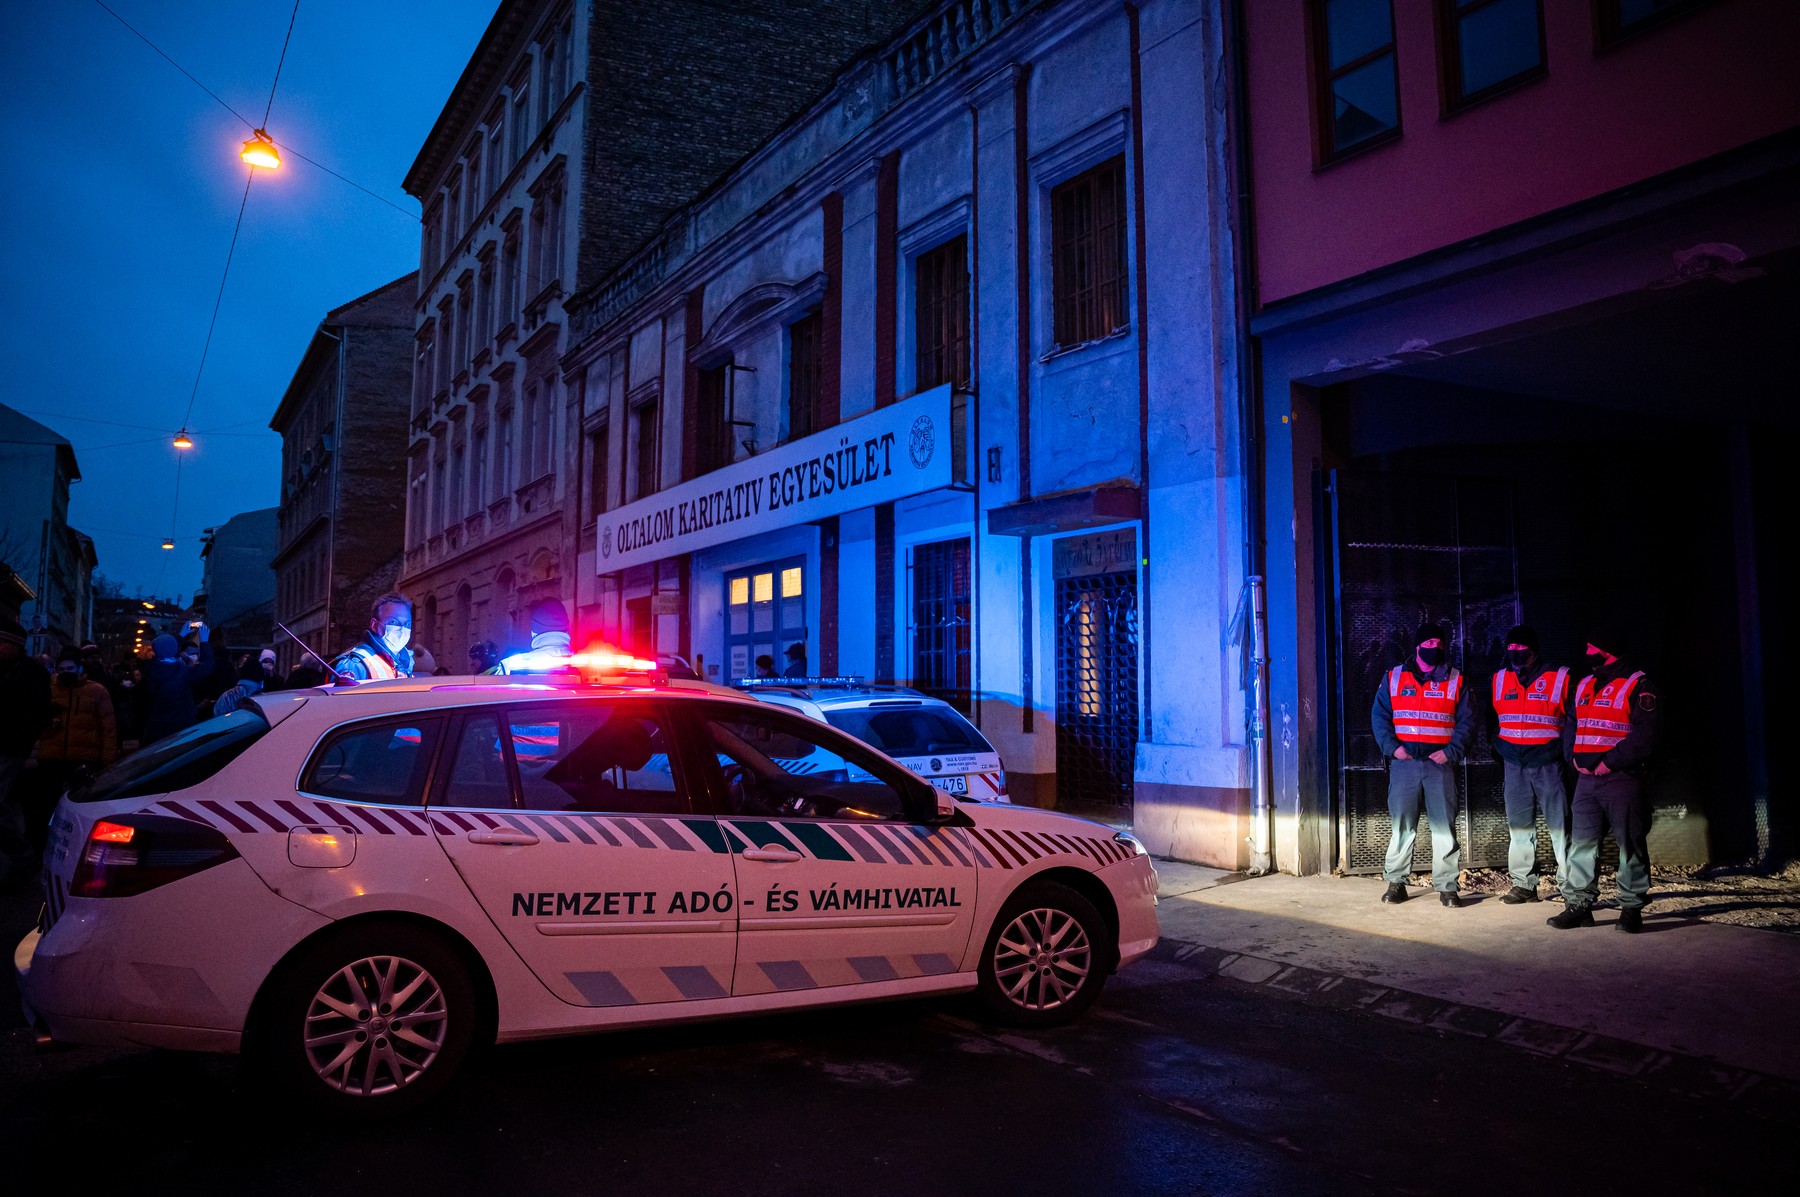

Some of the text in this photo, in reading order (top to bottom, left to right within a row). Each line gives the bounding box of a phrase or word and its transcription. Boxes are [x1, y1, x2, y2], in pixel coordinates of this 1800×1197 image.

[617, 506, 675, 554] OLTALOM
[678, 477, 764, 536] KARITATIV
[769, 432, 895, 511] EGYESÜLET
[907, 763, 923, 771] NAV
[512, 891, 657, 917] NEMZETI
[667, 882, 733, 914] ADÓ
[766, 882, 799, 913] ÉS
[809, 882, 962, 911] VÁMHIVATAL
